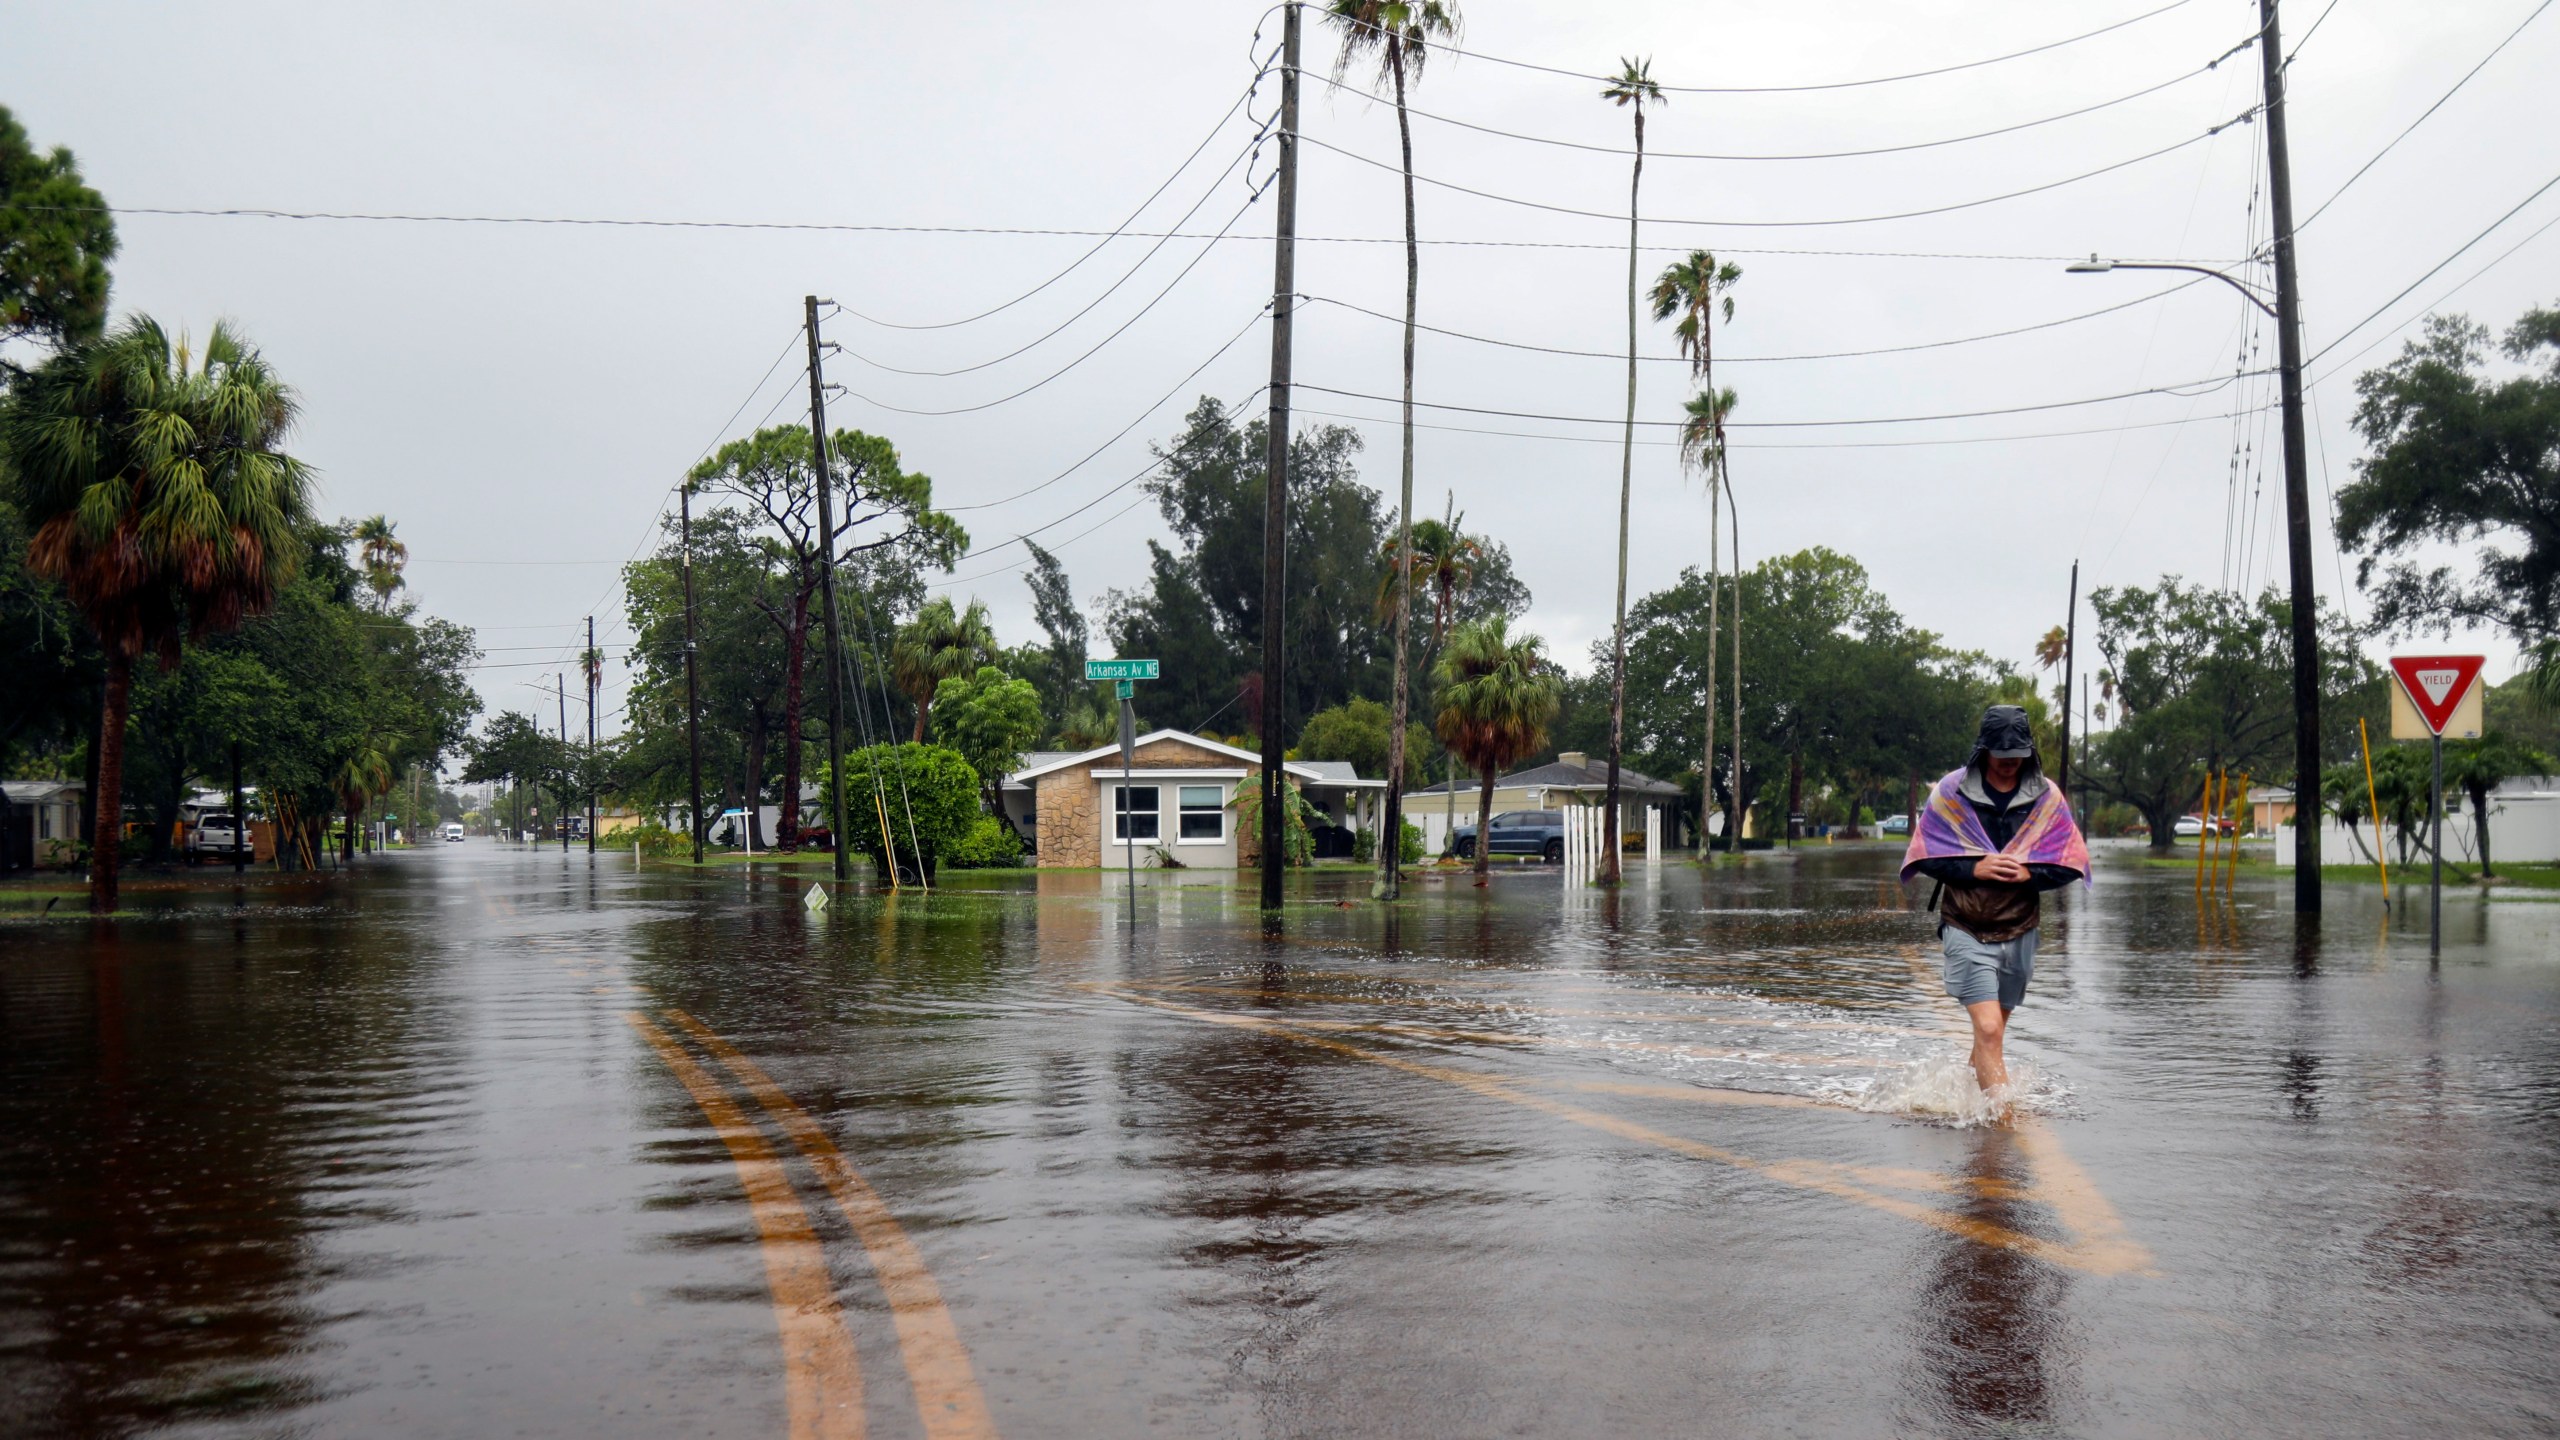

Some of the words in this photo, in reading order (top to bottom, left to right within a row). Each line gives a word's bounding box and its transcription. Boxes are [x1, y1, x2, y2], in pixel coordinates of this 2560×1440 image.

[1087, 663, 1128, 677] Arkansas
[1131, 662, 1142, 676] Av
[1146, 662, 1158, 676] NE
[2424, 675, 2452, 685] YIELD
